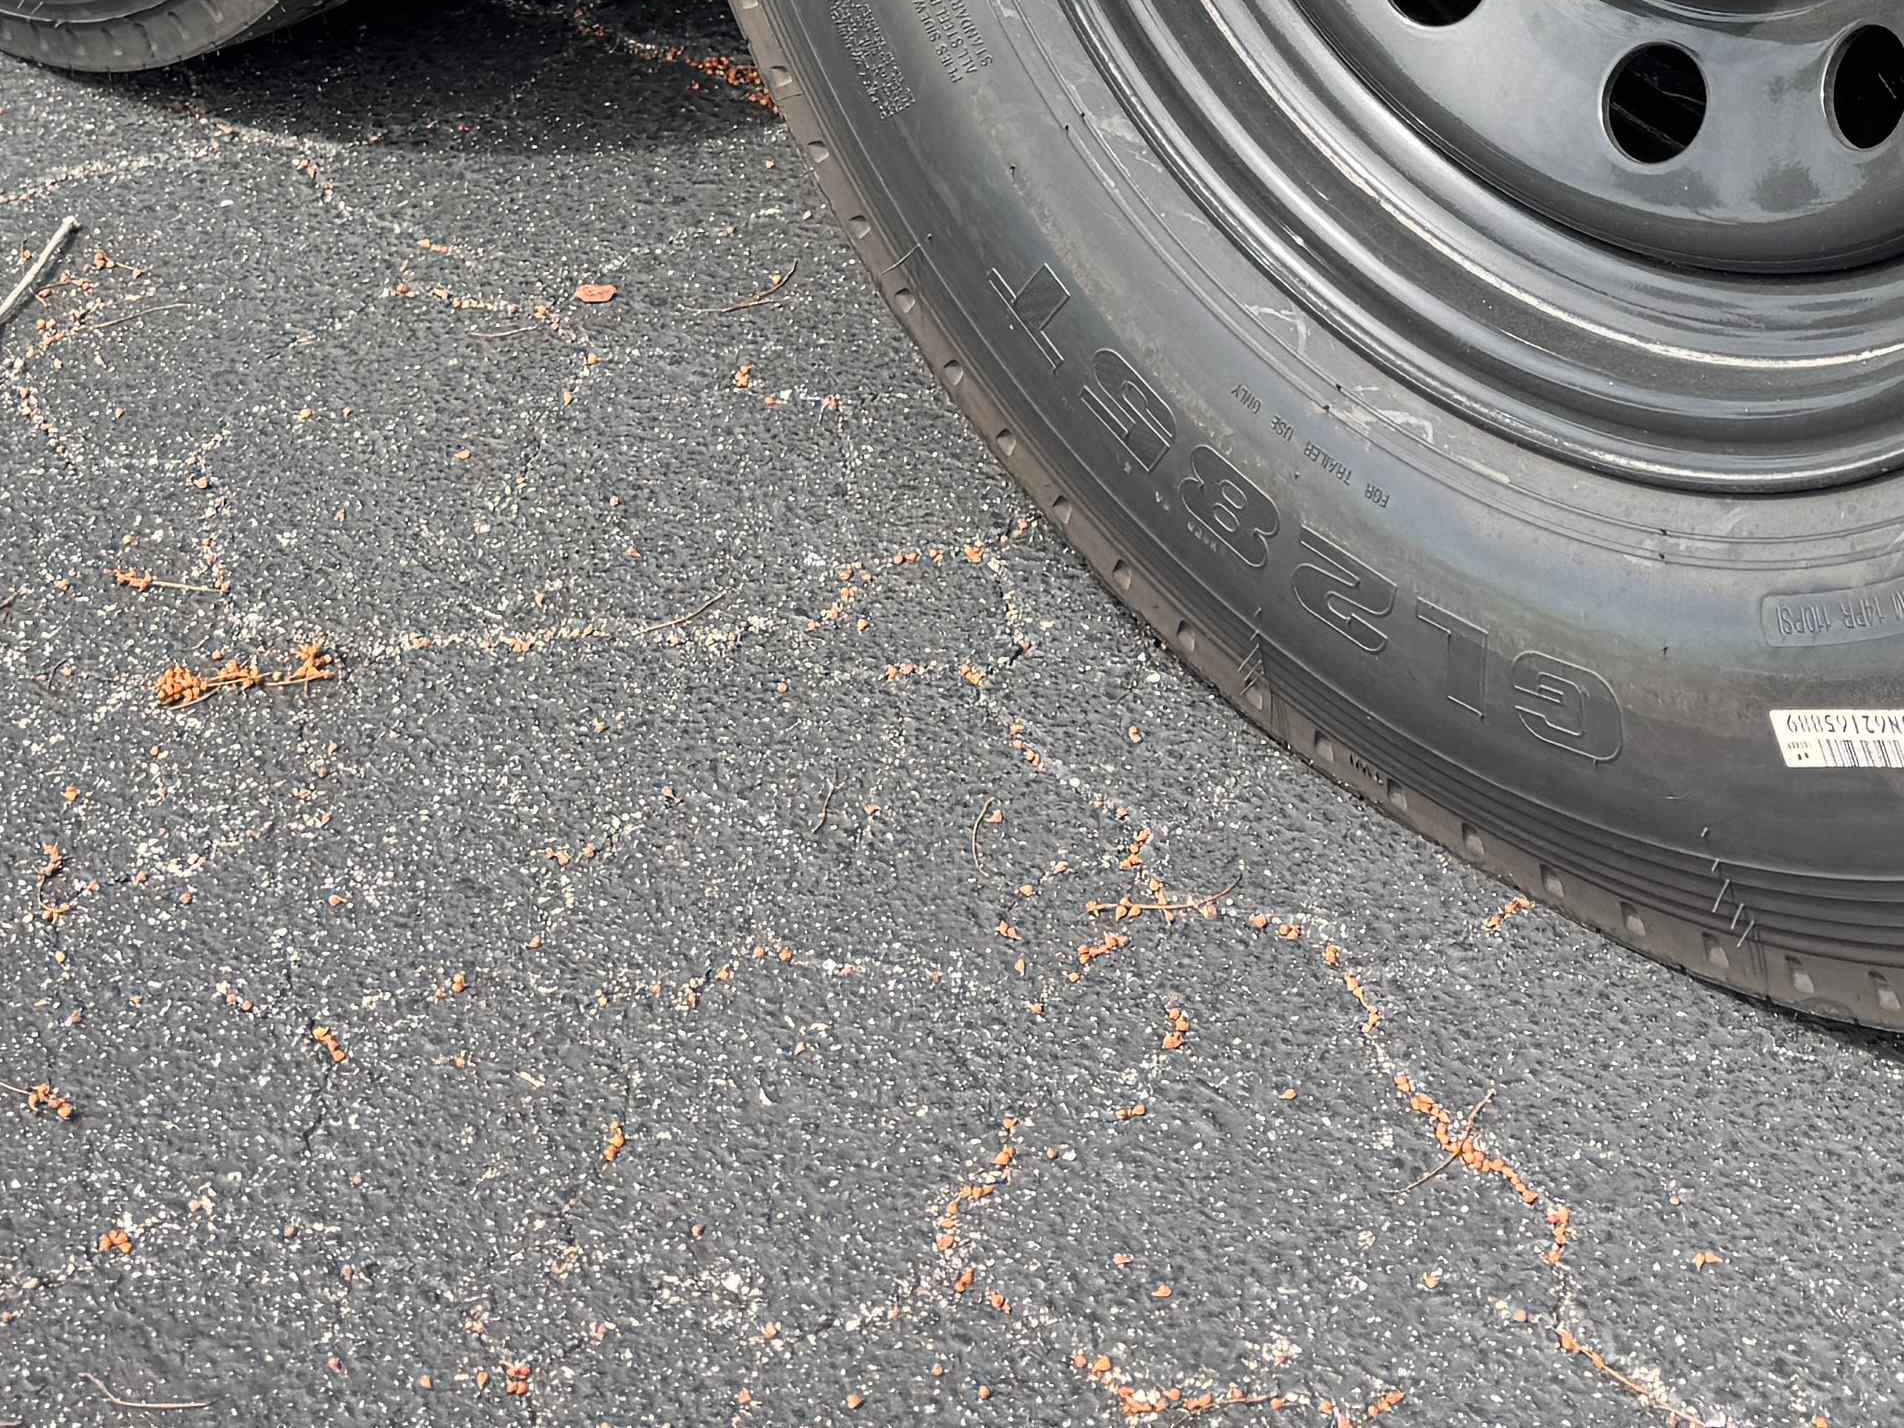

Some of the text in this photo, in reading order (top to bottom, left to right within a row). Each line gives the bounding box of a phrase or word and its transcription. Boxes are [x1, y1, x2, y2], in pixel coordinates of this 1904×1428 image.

[937, 6, 966, 49] STEEL
[1229, 380, 1392, 510] FOR TRAILER USE ONLY
[989, 262, 1624, 763] GL285T
[1776, 603, 1832, 635] 110PSI
[1841, 596, 1886, 630] 14PR
